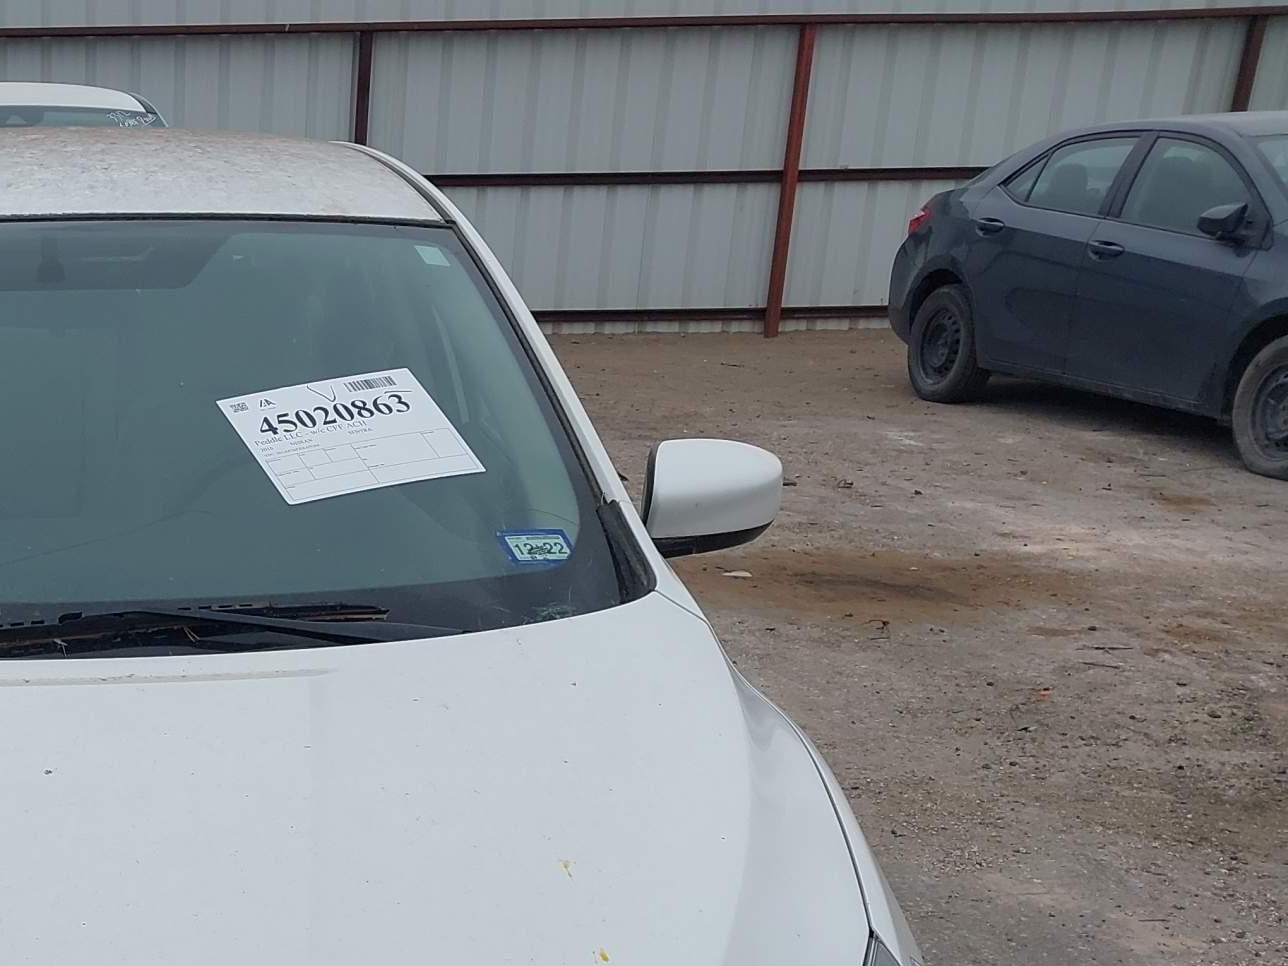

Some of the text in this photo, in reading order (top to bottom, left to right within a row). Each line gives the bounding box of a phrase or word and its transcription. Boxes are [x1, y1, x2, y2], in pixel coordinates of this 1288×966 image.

[259, 394, 410, 435] 45020863
[283, 431, 303, 441] LLC
[514, 542, 567, 555] 12 22
